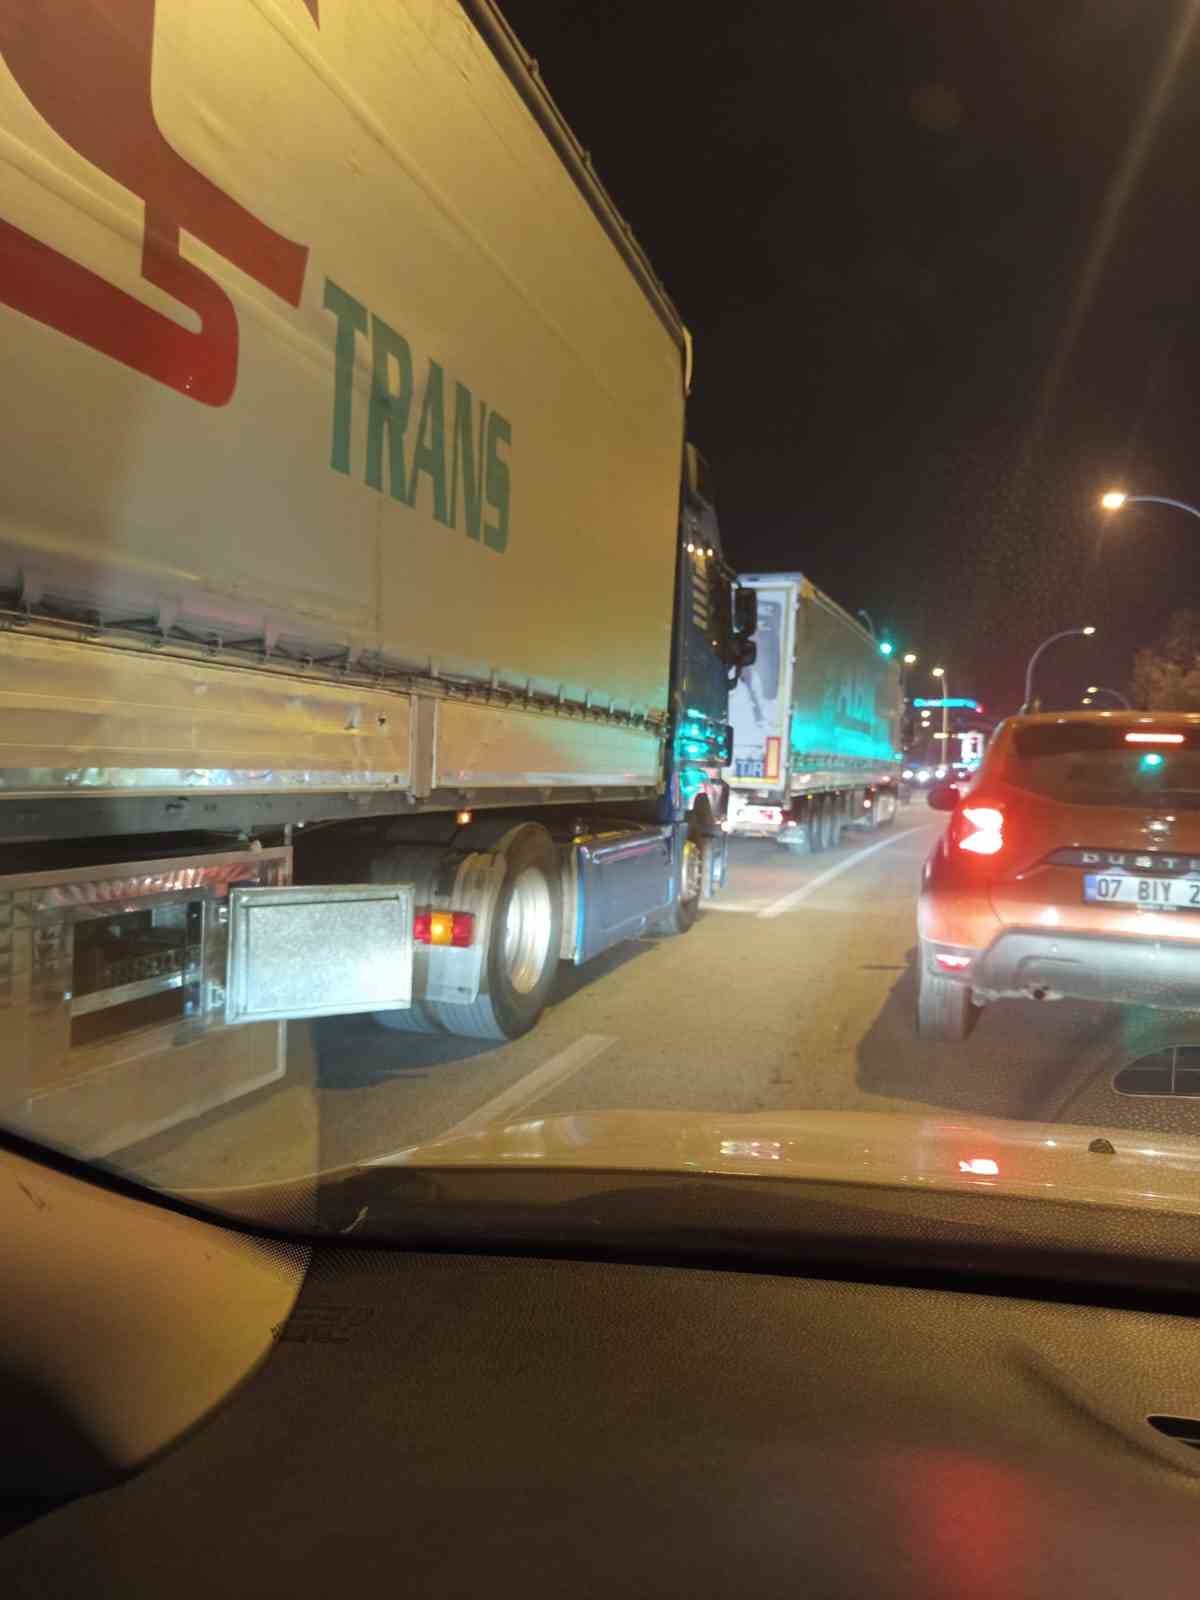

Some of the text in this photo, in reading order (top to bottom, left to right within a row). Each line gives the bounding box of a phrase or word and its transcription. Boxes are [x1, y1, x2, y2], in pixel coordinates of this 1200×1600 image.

[323, 276, 512, 555] TRANS
[1097, 878, 1123, 899] 07
[1137, 881, 1172, 902] BIY
